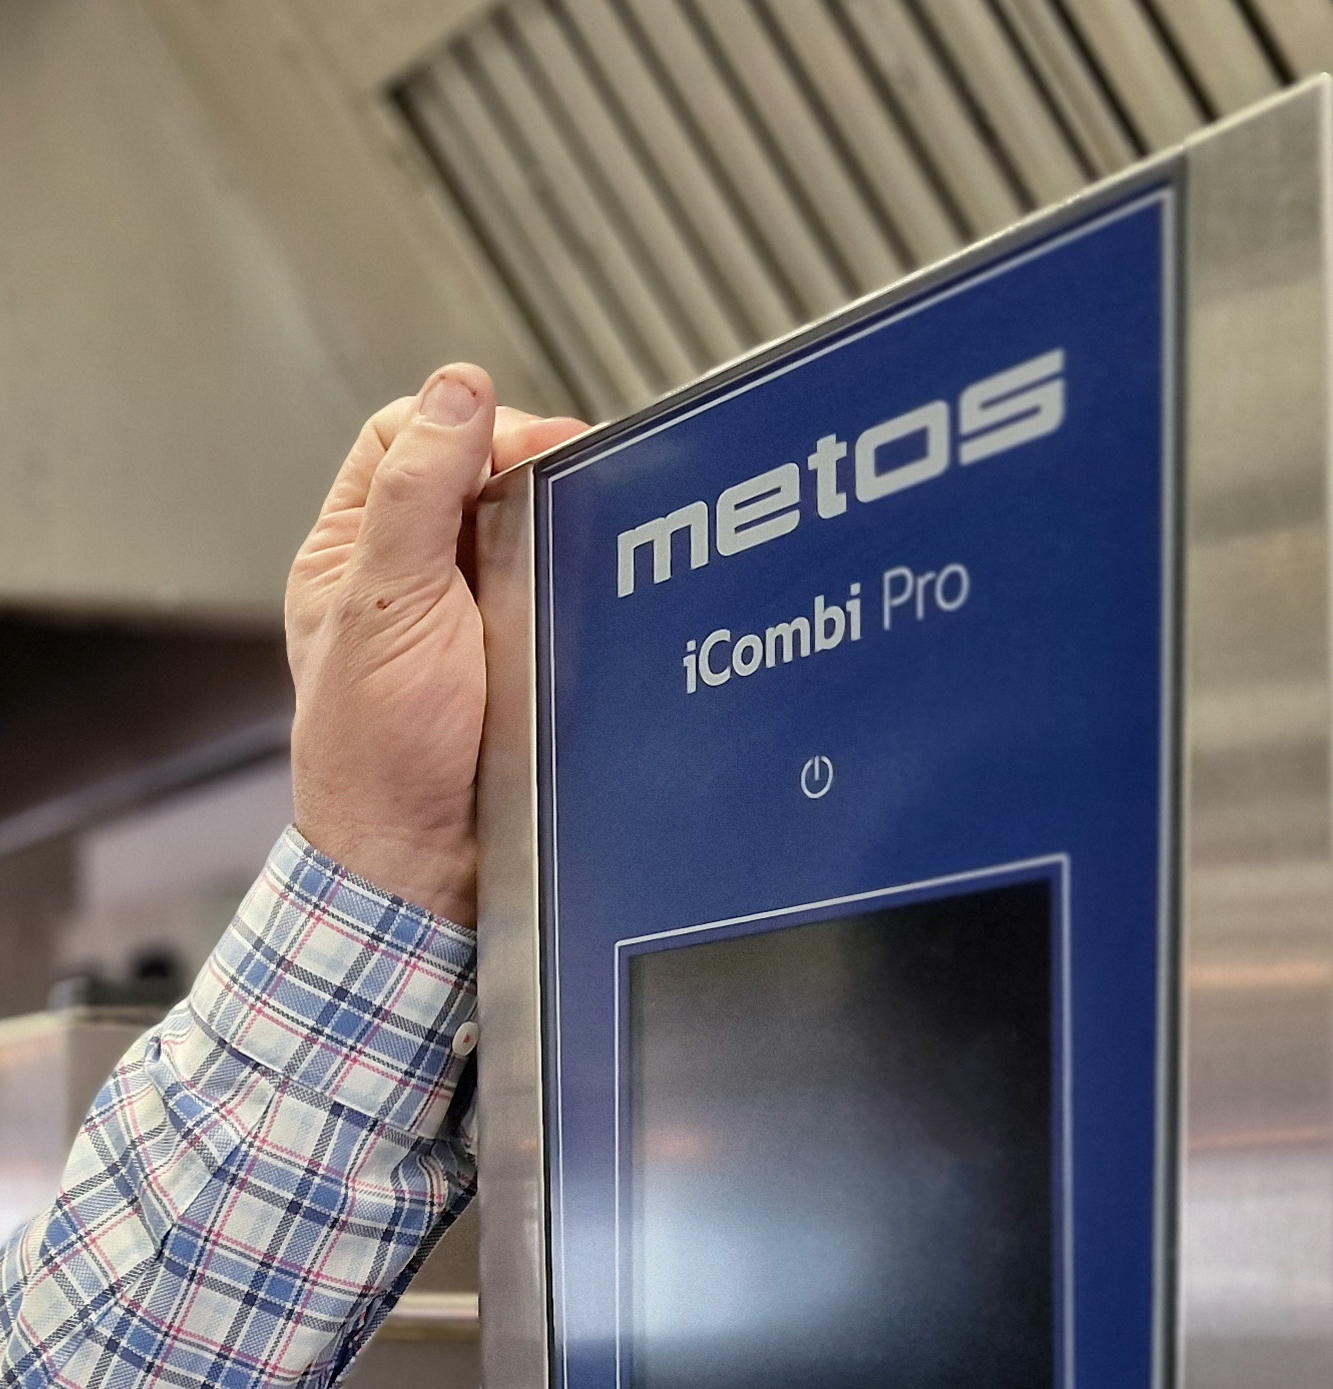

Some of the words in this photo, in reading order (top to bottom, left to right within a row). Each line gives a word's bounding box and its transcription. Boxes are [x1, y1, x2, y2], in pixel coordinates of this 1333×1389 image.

[617, 348, 1064, 599] metos
[682, 582, 861, 694] iCombi
[882, 564, 970, 630] Pro
